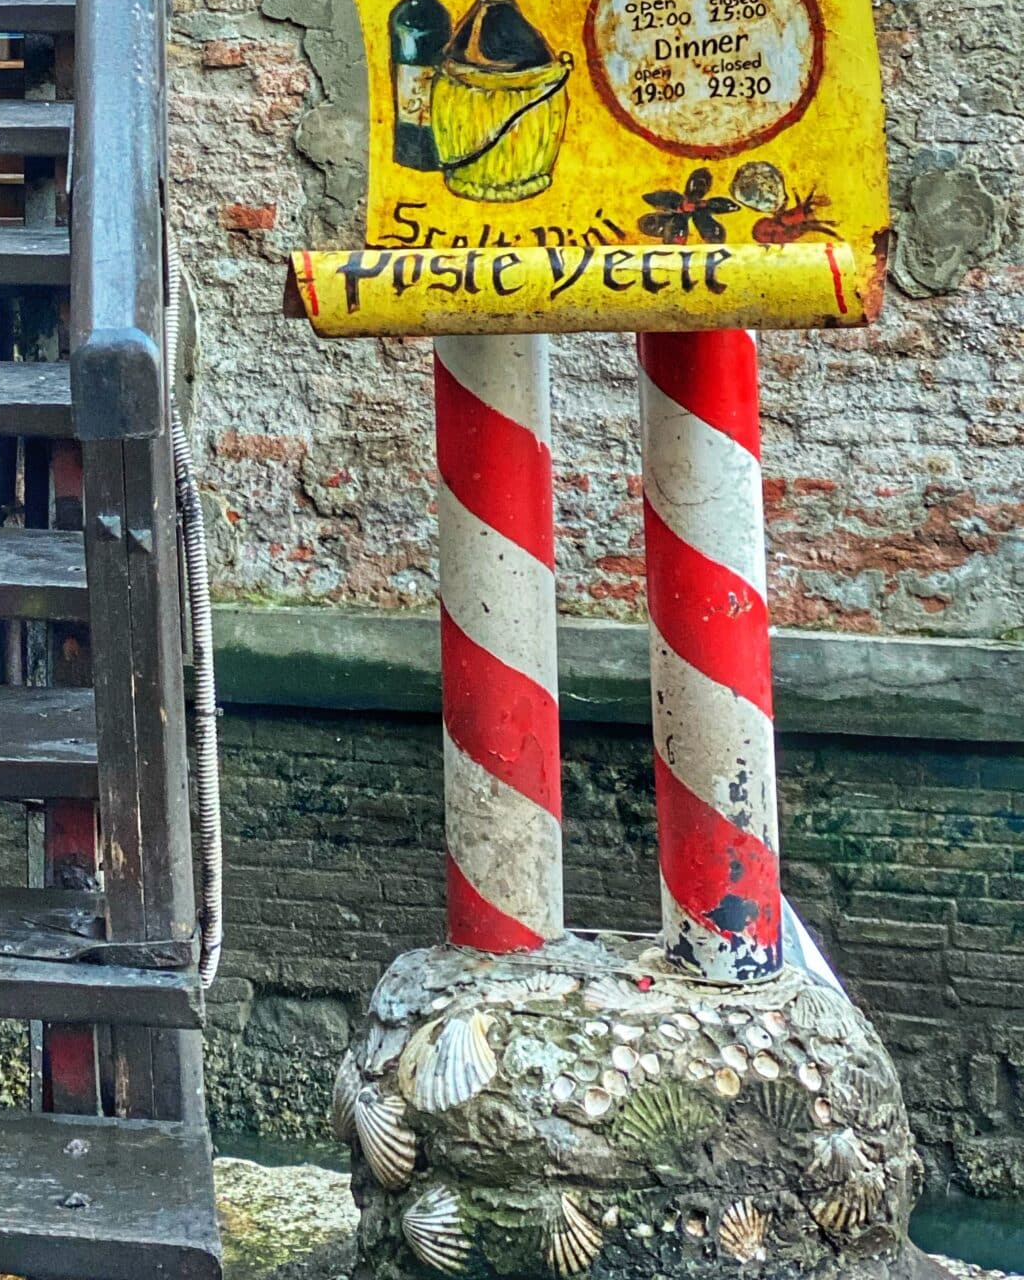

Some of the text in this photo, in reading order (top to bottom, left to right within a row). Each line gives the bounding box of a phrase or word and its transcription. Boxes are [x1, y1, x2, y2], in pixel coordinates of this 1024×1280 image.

[625, 0, 677, 15] open
[631, 4, 767, 32] 12:00 15:00
[655, 33, 749, 60] Dinner
[634, 53, 762, 82] open closed
[632, 76, 772, 106] 19:00 22:30
[336, 246, 732, 314] Poste Vecie
